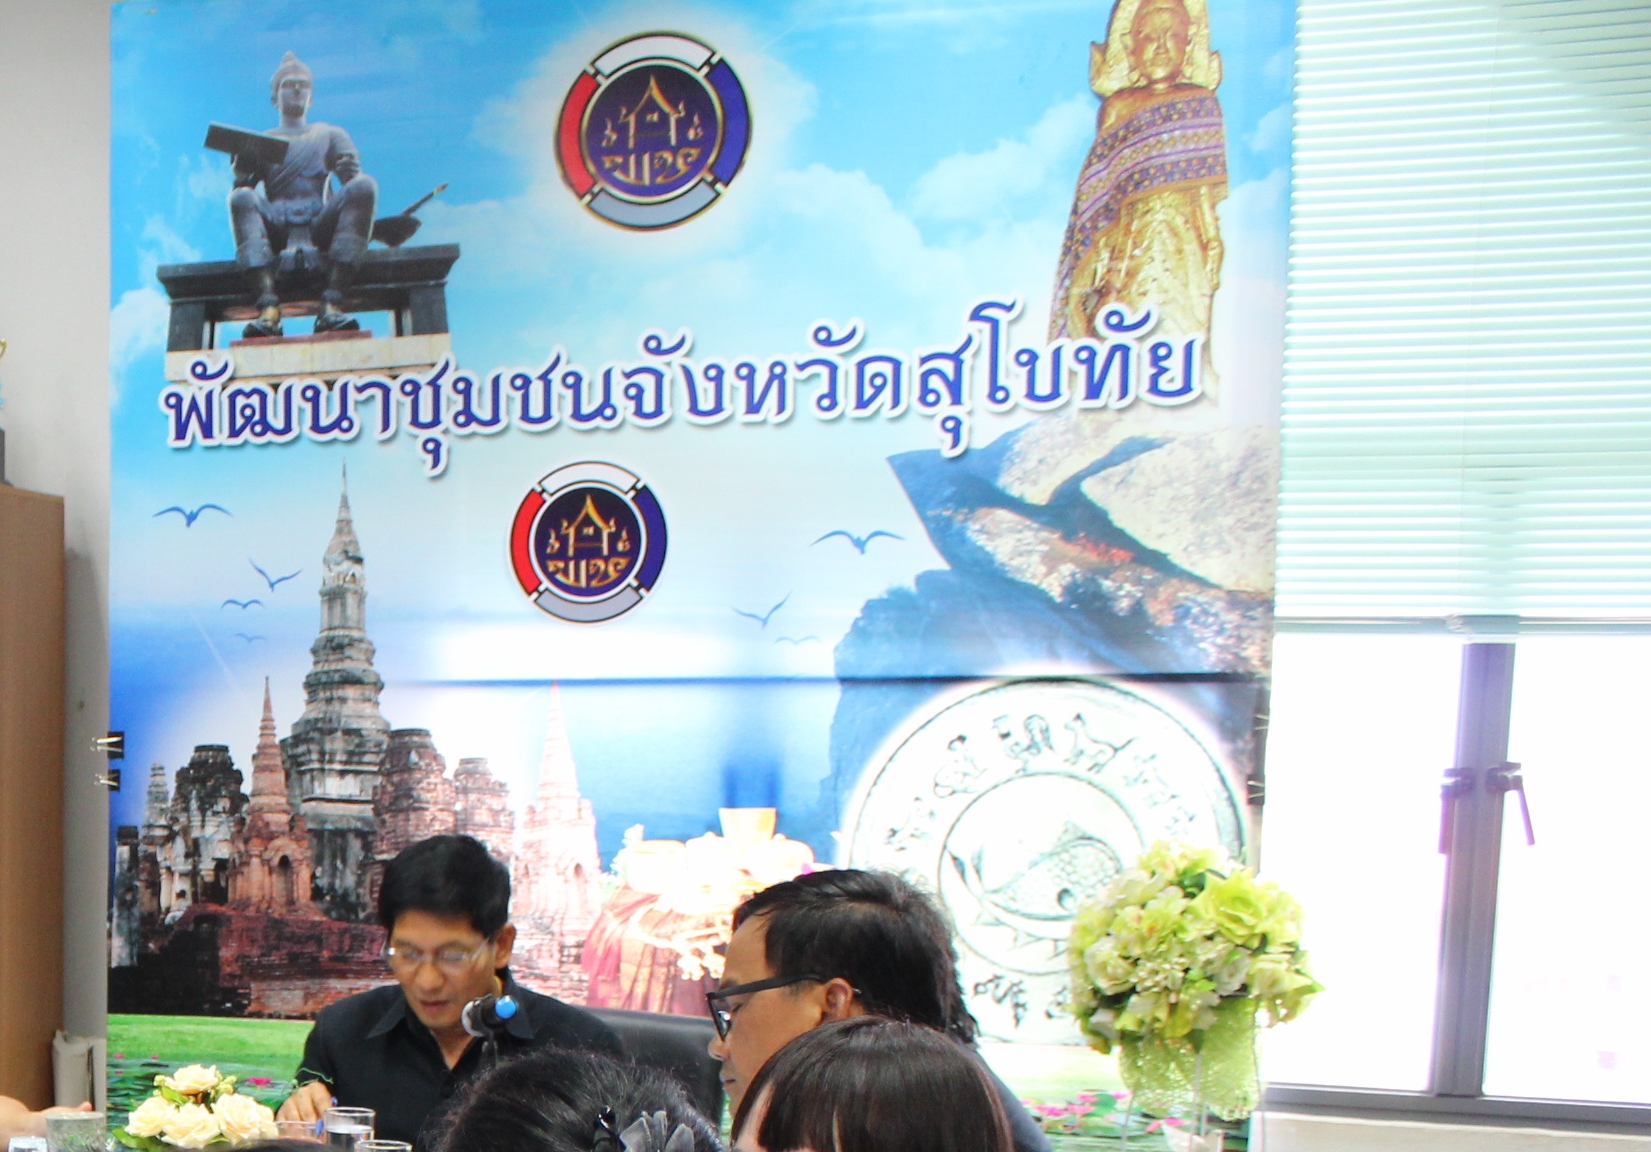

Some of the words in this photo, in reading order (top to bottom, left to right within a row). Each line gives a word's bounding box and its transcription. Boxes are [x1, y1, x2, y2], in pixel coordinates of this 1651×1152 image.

[164, 299, 1197, 471] พัฒนาชุมชนจังหวัดสุโขทัย
